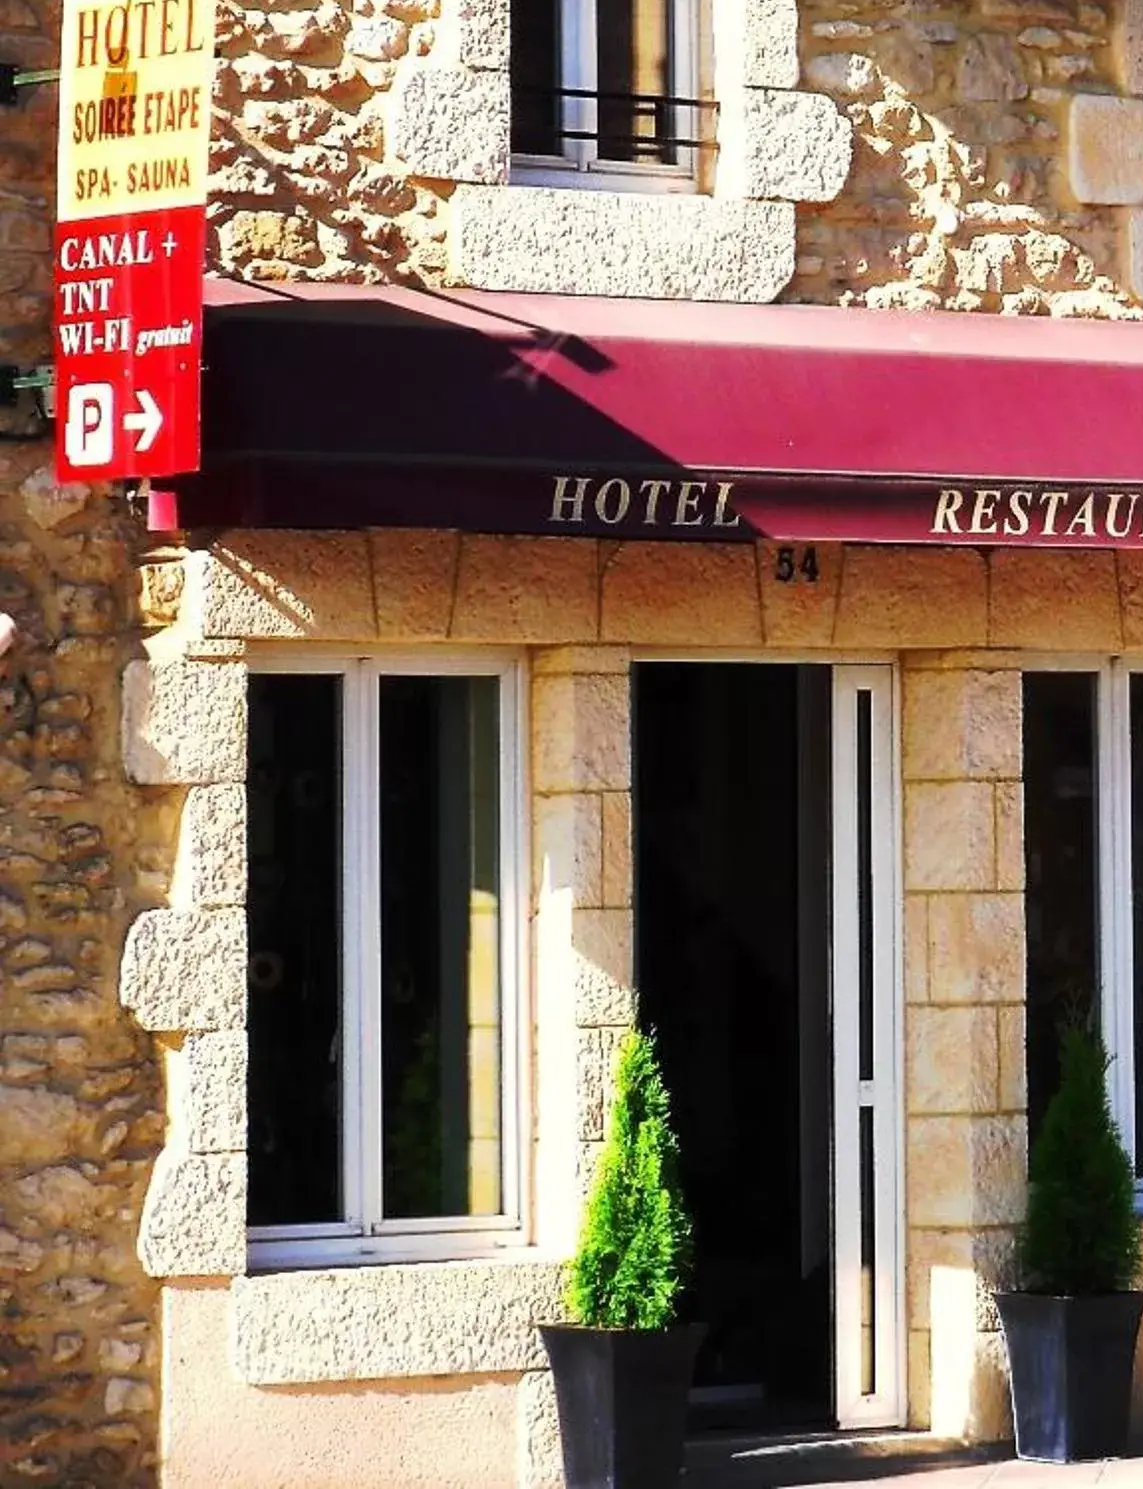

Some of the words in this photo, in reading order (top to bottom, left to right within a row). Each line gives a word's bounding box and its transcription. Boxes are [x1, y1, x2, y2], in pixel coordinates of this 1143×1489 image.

[143, 87, 201, 134] ETAPE
[127, 157, 191, 194] SAUNA
[60, 230, 153, 272] CANAL
[60, 278, 114, 315] TNT
[59, 317, 132, 356] WI-FI
[135, 319, 194, 356] gratuit
[549, 476, 741, 527] HOTEL
[774, 547, 820, 583] 54
